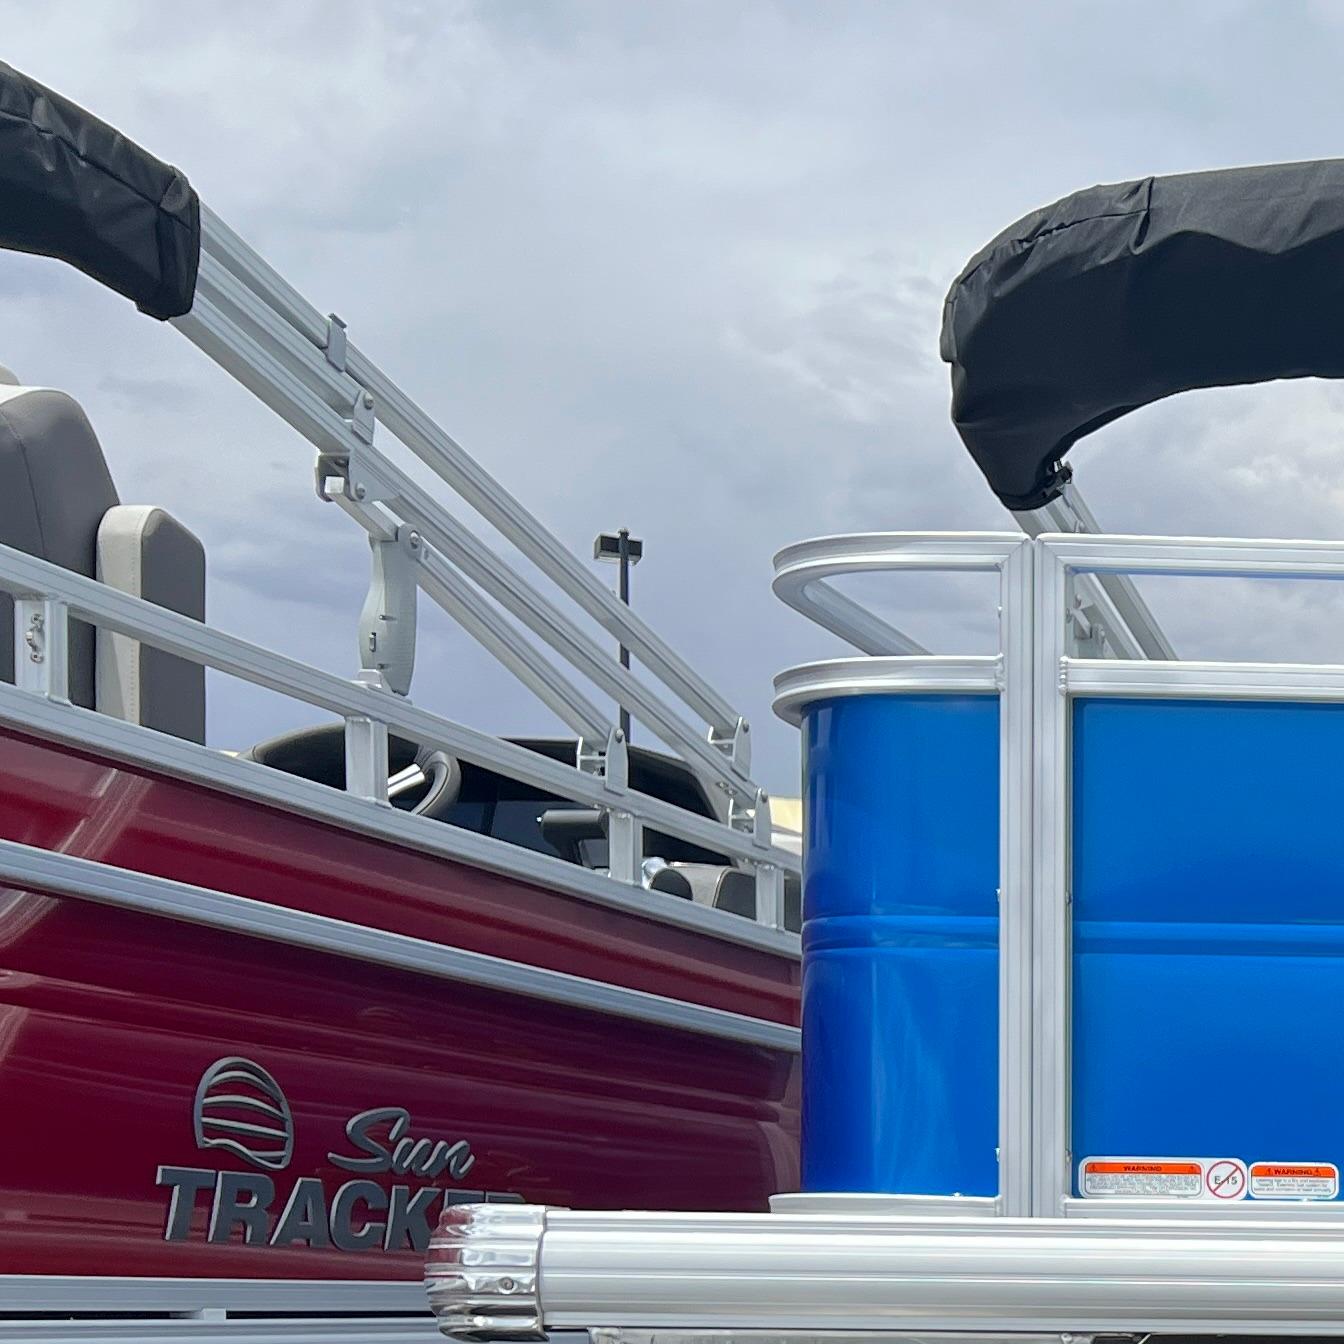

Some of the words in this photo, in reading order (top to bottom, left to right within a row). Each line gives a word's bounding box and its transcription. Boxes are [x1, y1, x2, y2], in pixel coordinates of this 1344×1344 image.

[327, 1106, 477, 1180] Sun
[1274, 1168, 1313, 1176] WARNING
[155, 1165, 527, 1253] TRACK
